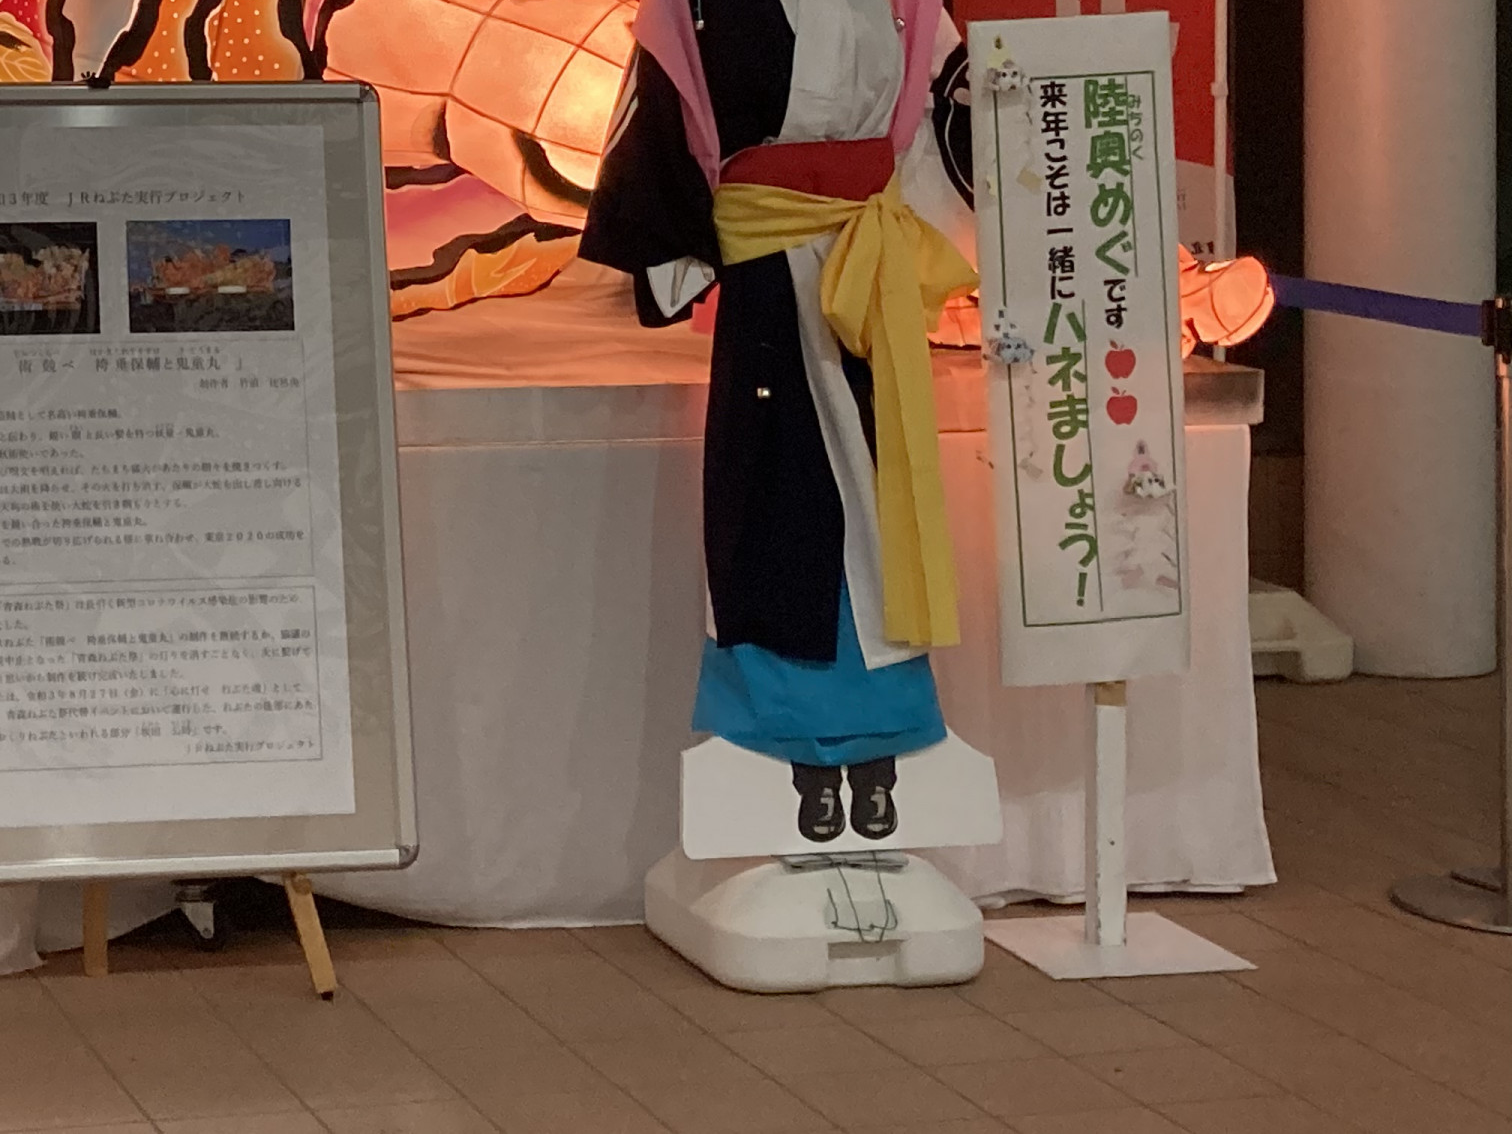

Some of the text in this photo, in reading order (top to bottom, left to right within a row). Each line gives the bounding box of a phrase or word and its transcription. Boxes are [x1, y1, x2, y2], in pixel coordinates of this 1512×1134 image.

[1084, 77, 1134, 329] 陸奥めぐです
[1128, 94, 1144, 161] みちのく
